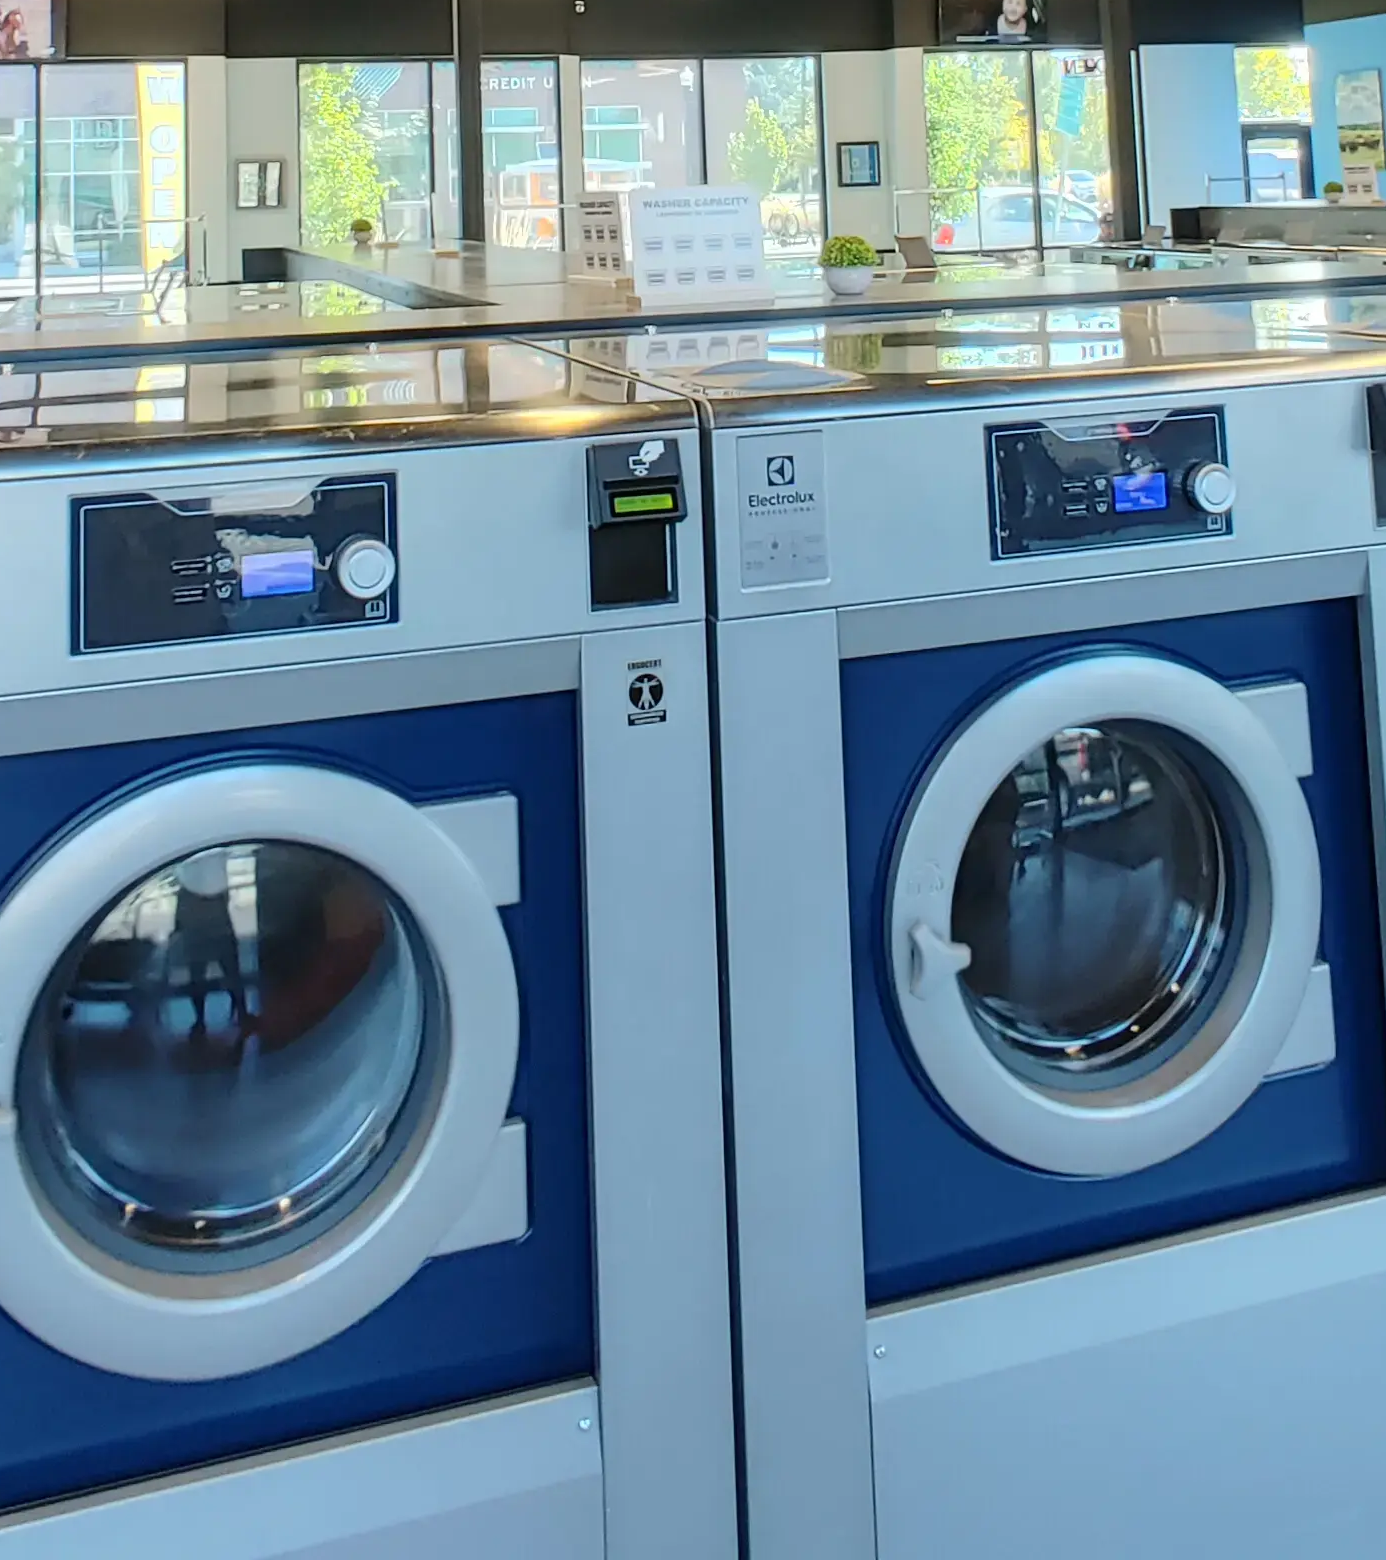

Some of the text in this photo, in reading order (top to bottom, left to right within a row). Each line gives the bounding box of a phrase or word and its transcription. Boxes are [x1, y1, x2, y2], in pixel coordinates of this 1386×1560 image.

[149, 124, 180, 249] OPEN
[642, 196, 749, 209] WASHER CAPACITY
[748, 491, 815, 507] Electrolux
